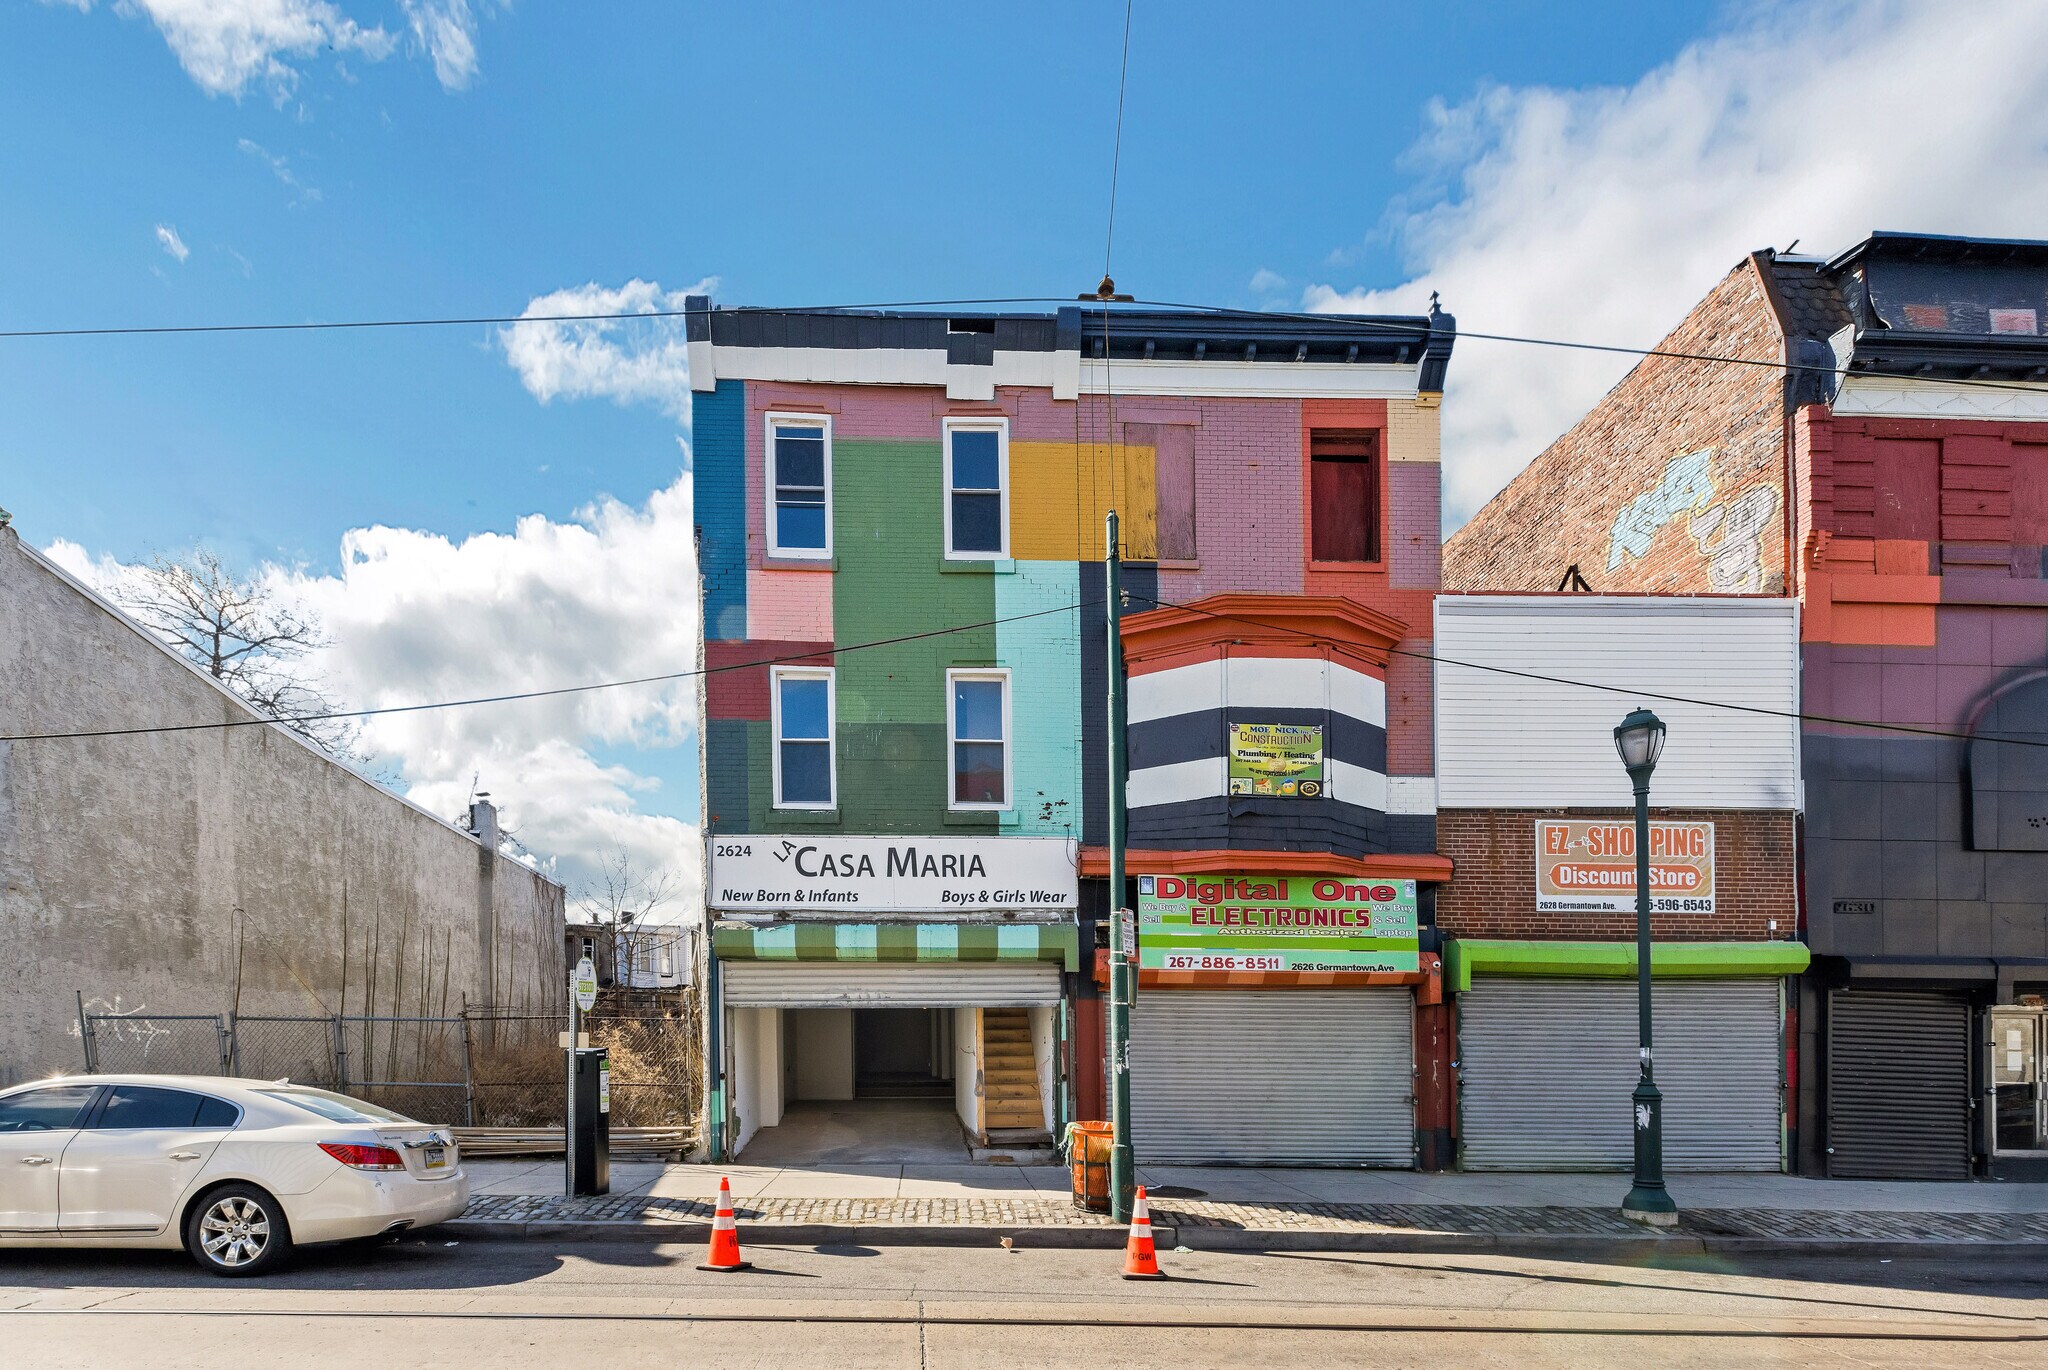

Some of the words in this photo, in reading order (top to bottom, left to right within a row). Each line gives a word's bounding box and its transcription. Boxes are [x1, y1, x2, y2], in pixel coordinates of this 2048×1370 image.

[1240, 732, 1311, 745] CONSTRUCTION
[1237, 749, 1277, 760] Plumbing
[1277, 751, 1283, 759] /
[1284, 751, 1315, 760] Heating
[1544, 826, 1570, 856] EZ
[1586, 826, 1706, 857] SHOPING
[716, 845, 752, 857] 2624
[773, 839, 797, 863] LA
[794, 846, 876, 878] CASA
[886, 847, 987, 878] MARIA
[1559, 865, 1638, 886] Discount
[1648, 867, 1696, 886] Store
[721, 889, 754, 902] New
[756, 889, 791, 902] Born
[794, 889, 805, 902] &
[808, 888, 859, 903] Infants
[1156, 877, 1289, 905] Digital
[1312, 879, 1397, 902] One
[941, 889, 975, 906] Boys
[978, 890, 990, 903] &
[993, 889, 1026, 903] Girls
[1029, 890, 1067, 903] Wear
[1142, 903, 1157, 912] We
[1159, 903, 1178, 913] Buy
[1179, 904, 1188, 912] &
[1372, 904, 1390, 912] We
[1392, 904, 1415, 913] Buy
[1539, 901, 1557, 910] 2628
[1558, 901, 1602, 911] Germantown
[1603, 902, 1617, 910] Ave.
[1634, 899, 1712, 912] 25-596-6543
[1143, 915, 1160, 923] Sell
[1190, 906, 1371, 928] ELECTRONICS
[1373, 916, 1382, 924] &
[1386, 916, 1407, 924] Sell
[1217, 927, 1305, 936] Authorized
[1308, 928, 1363, 937] Dealer
[1373, 928, 1414, 938] Laptop
[1168, 956, 1280, 970] 267-886-8511
[1291, 963, 1314, 972] 2626
[1377, 964, 1395, 972] Ave
[1132, 1252, 1152, 1261] PGW
